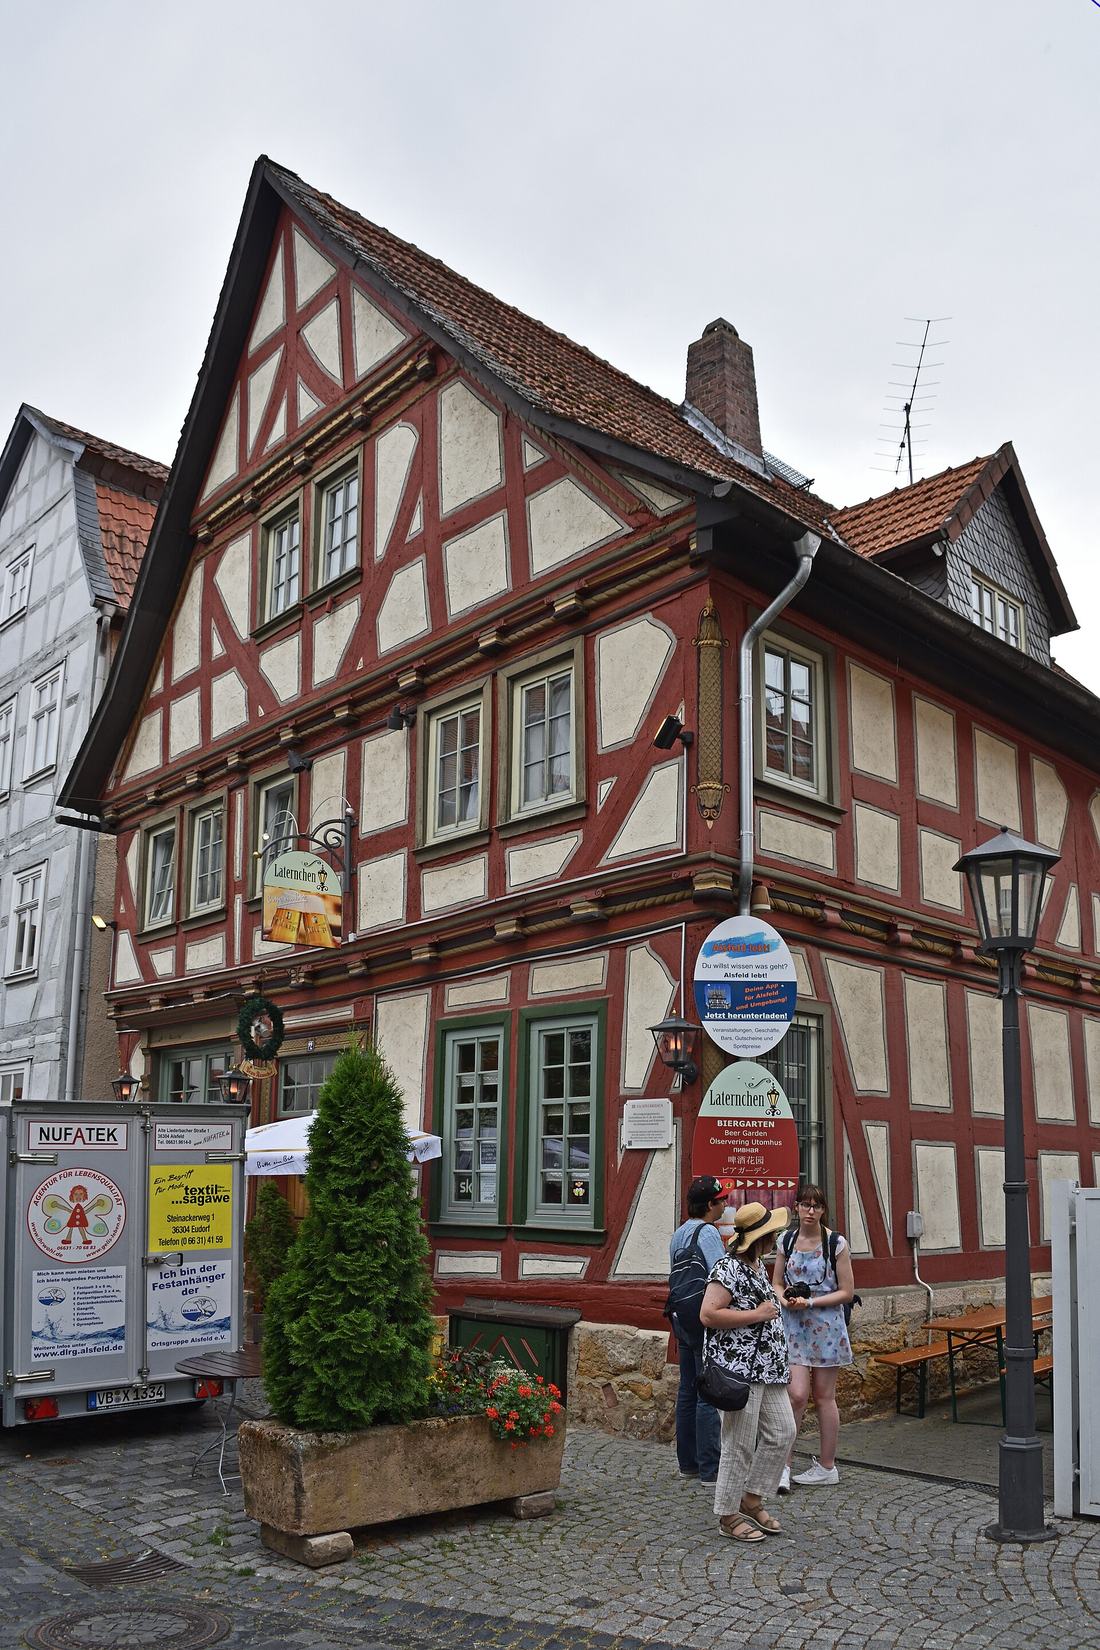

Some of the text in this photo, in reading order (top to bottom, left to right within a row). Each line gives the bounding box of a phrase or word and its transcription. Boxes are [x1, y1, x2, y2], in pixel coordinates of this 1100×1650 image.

[274, 863, 316, 883] Laternchen
[770, 963, 788, 971] geht?
[765, 983, 779, 991] App
[755, 990, 779, 999] Alsfeld
[750, 996, 787, 1008] Umgebung!
[709, 1089, 765, 1107] Laternchen
[717, 1120, 775, 1128] BIERGARTEN
[39, 1127, 118, 1143] NUFATEK
[709, 1137, 750, 1146] Ölservering
[727, 1156, 765, 1165] 啤酒花园
[168, 1169, 194, 1181] Begriff
[722, 1167, 770, 1175] ビアガーデン
[33, 1170, 123, 1206] AGENTUR FÜR LEBENSQUALITÄT
[155, 1182, 184, 1195] für Mode
[184, 1185, 217, 1195] textil
[167, 1214, 210, 1223] Steinackerweg
[191, 1225, 210, 1233] Eudorf
[158, 1238, 179, 1246] Telefon
[181, 1237, 187, 1247] (0
[197, 1237, 206, 1245] 31)
[160, 1264, 217, 1279] Ich bin der
[152, 1272, 226, 1291] Festanhänger
[181, 1287, 199, 1296] der
[151, 1339, 189, 1347] Ortsgruppe
[190, 1335, 213, 1343] Alsfeld
[34, 1344, 123, 1358] www.dlrg.alsfeld.de
[97, 1392, 113, 1405] VB
[122, 1390, 130, 1402] X
[133, 1386, 163, 1400] 1334
